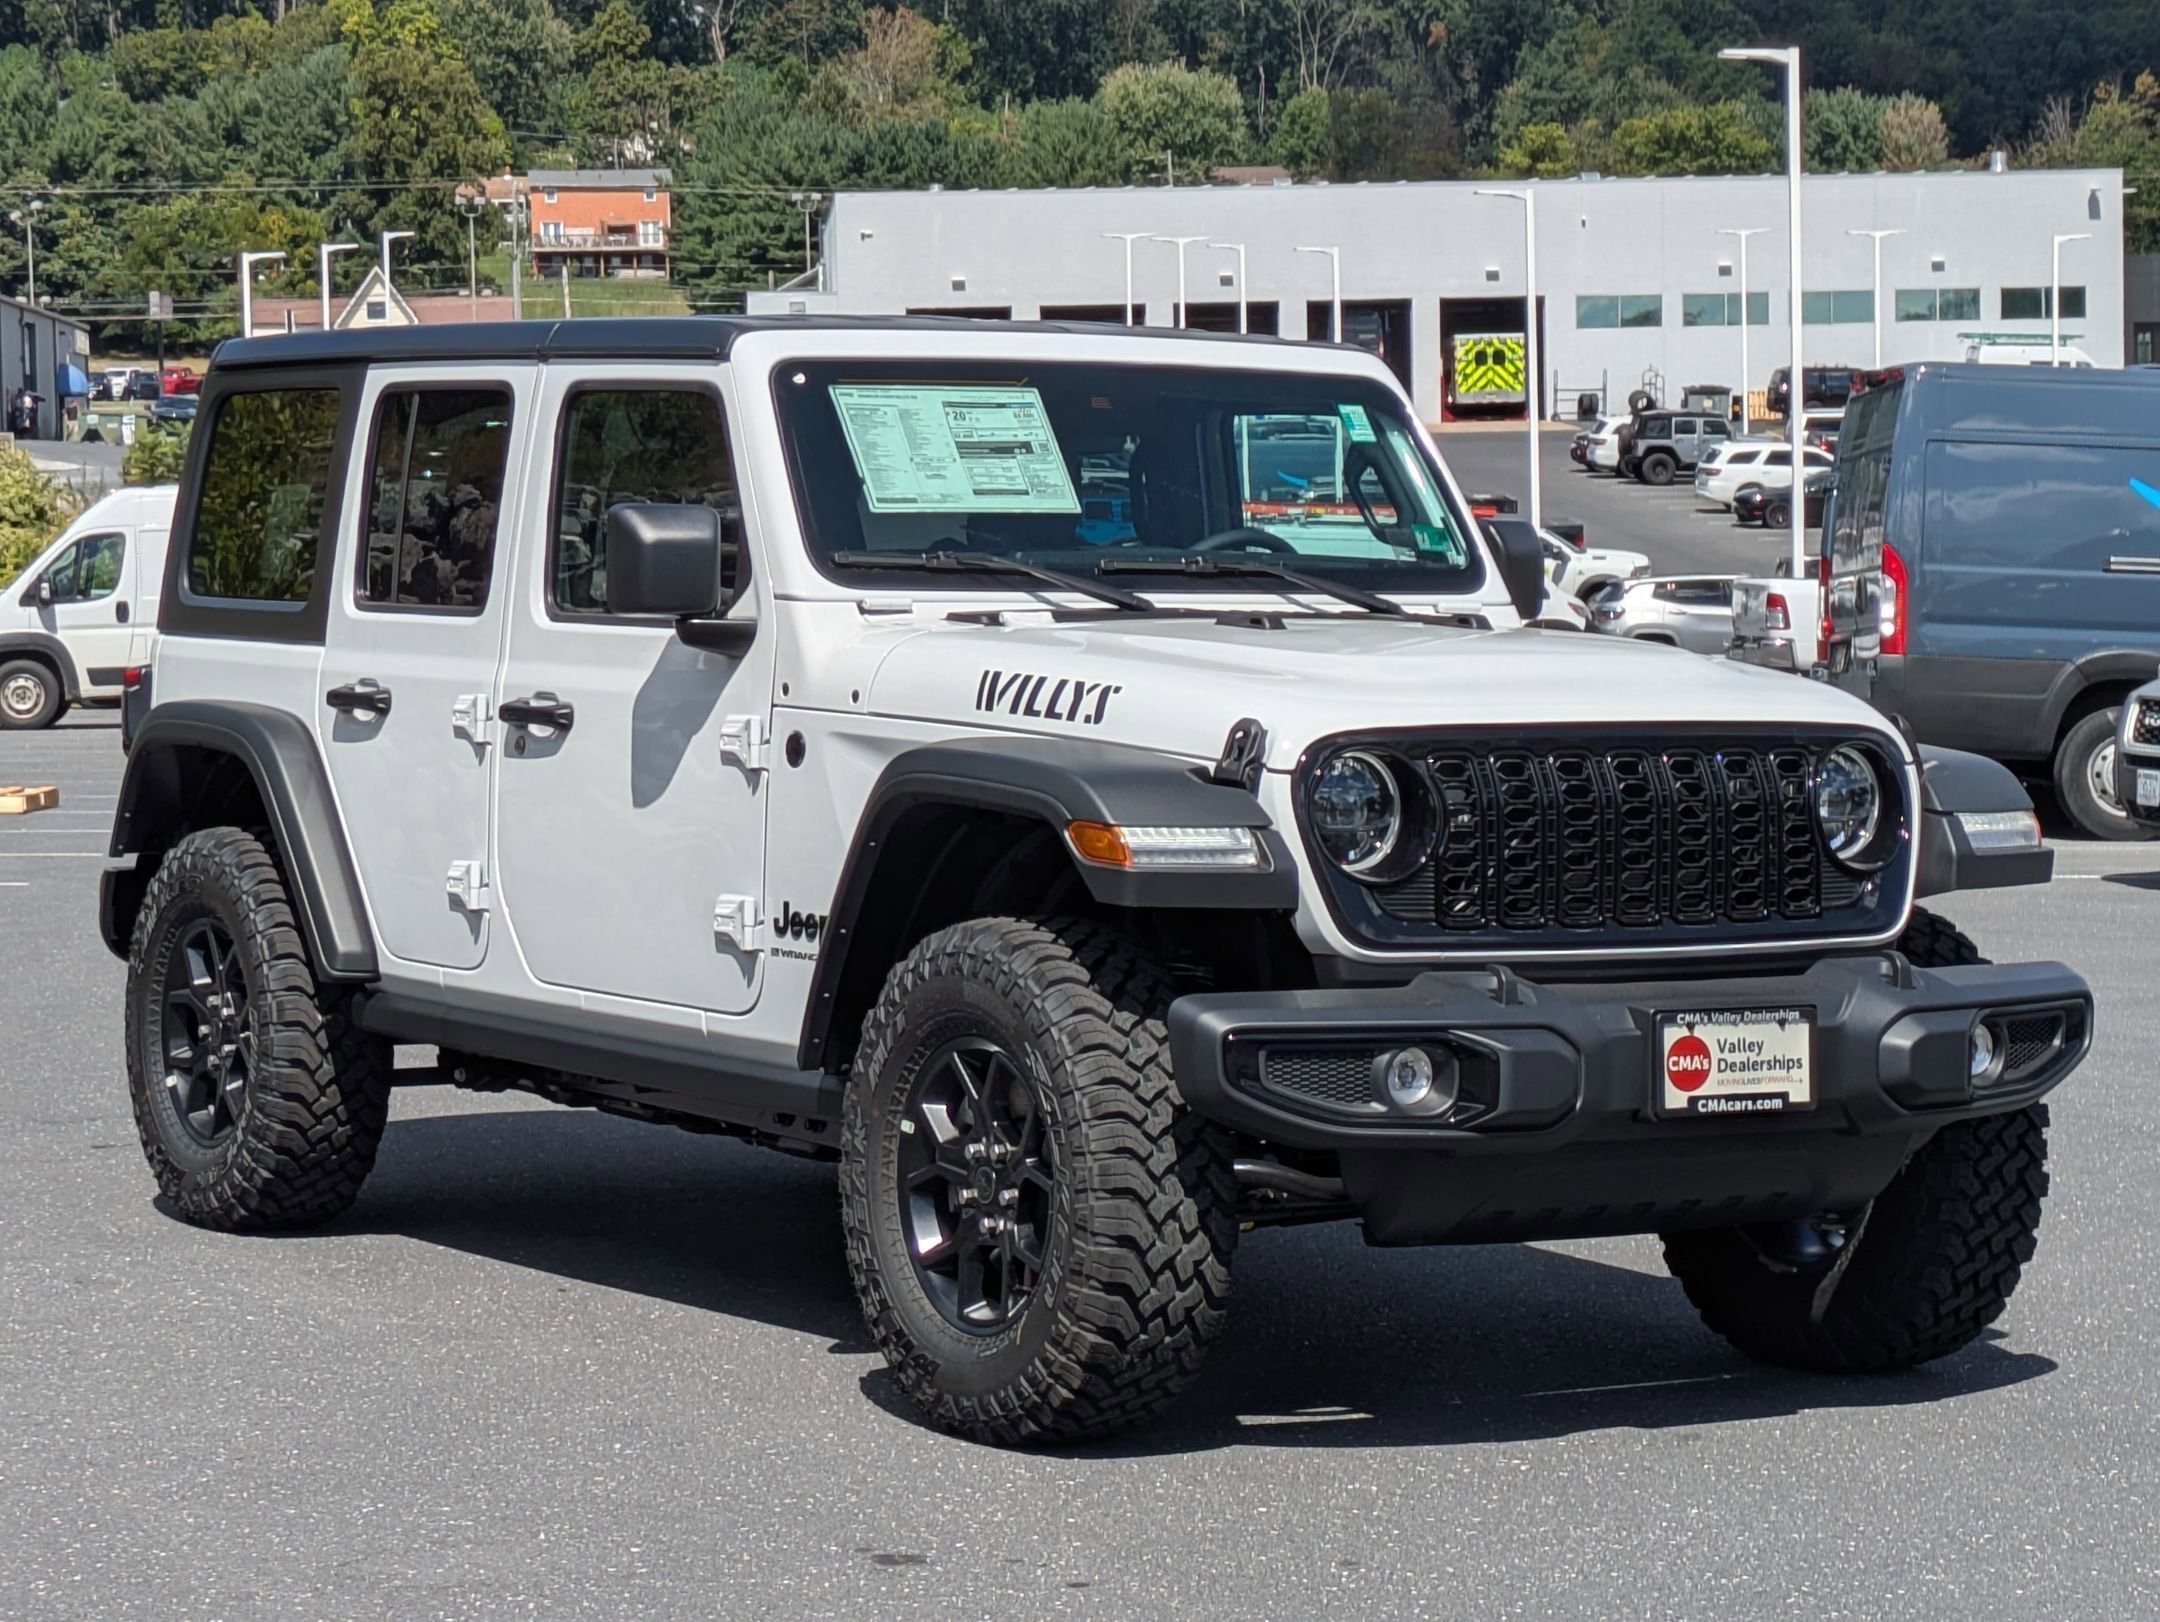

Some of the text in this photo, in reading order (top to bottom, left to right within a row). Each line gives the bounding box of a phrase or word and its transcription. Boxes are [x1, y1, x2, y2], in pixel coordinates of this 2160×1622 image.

[975, 669, 1123, 725] WILLYS
[1677, 1009, 1800, 1024] CMA's Valley Dealerships
[1717, 1038, 1764, 1056] Valley
[1668, 1055, 1710, 1072] CMA's
[1717, 1055, 1803, 1074] Dealerships
[1697, 1098, 1783, 1113] CMAcars.com
